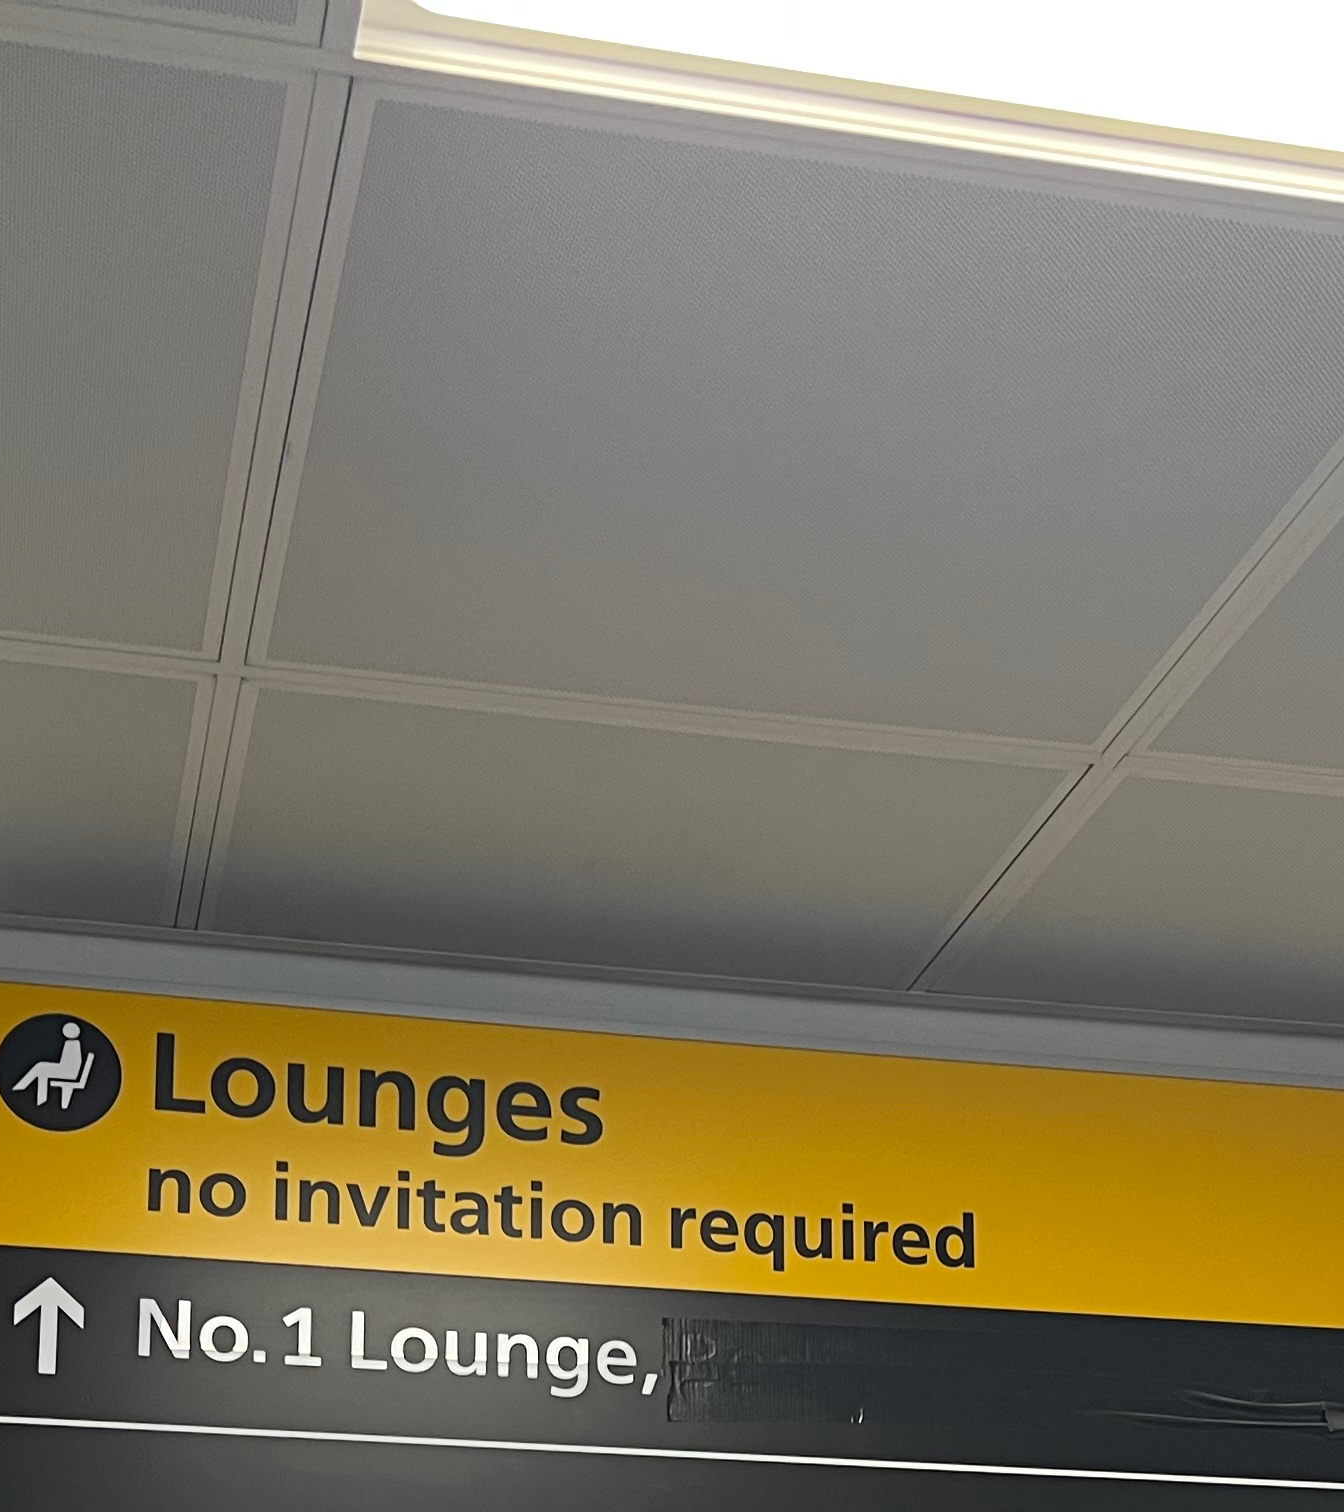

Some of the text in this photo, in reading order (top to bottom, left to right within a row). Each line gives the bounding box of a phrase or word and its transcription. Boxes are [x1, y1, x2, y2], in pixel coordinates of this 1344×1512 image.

[155, 1032, 603, 1156] Lounges
[147, 1160, 976, 1272] no invitation required
[350, 1310, 658, 1398] Lounge,
